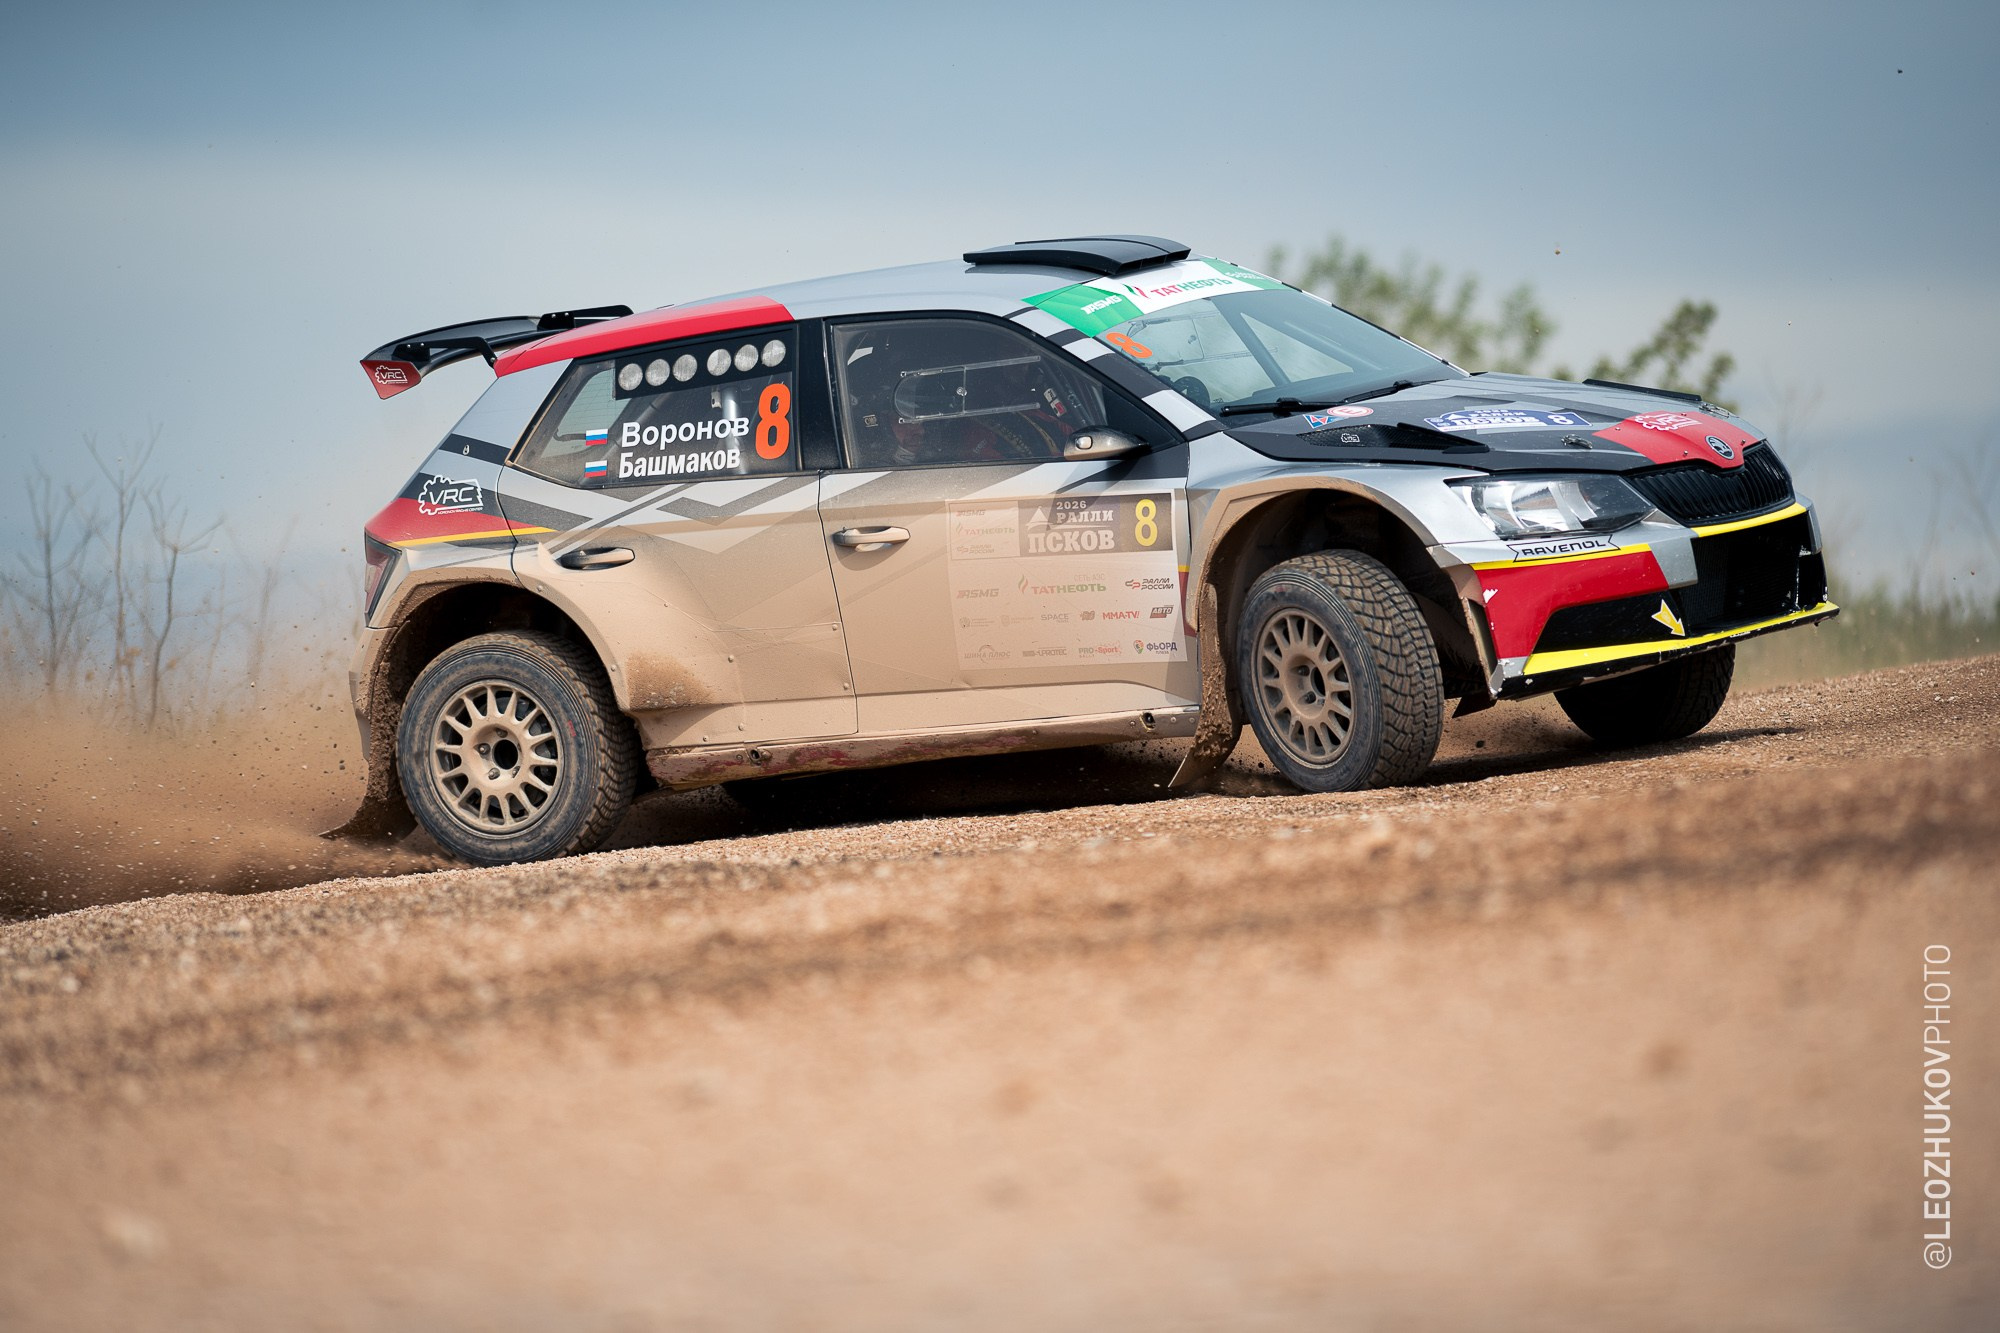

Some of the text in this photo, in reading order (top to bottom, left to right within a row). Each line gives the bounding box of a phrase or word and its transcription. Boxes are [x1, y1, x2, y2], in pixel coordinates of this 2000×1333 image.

[1151, 278, 1232, 297] ТАТНЕФТЬ
[1106, 332, 1152, 359] 8
[755, 383, 791, 460] 8
[1451, 416, 1540, 426] ПСКОВ
[1547, 415, 1575, 425] 8
[622, 417, 750, 450] Воронов
[618, 449, 741, 479] Башмаков
[429, 487, 474, 505] VRC
[1056, 500, 1087, 510] 2026
[1056, 510, 1114, 523] РАЛЛИ
[1135, 499, 1158, 547] 8
[1028, 530, 1115, 553] ПСКОВ
[1522, 540, 1606, 556] RAVENOL
[1031, 583, 1106, 595] ТАТНЕФТЬ
[1041, 613, 1069, 621] SPACE
[1146, 642, 1177, 651] ФЬОРД
